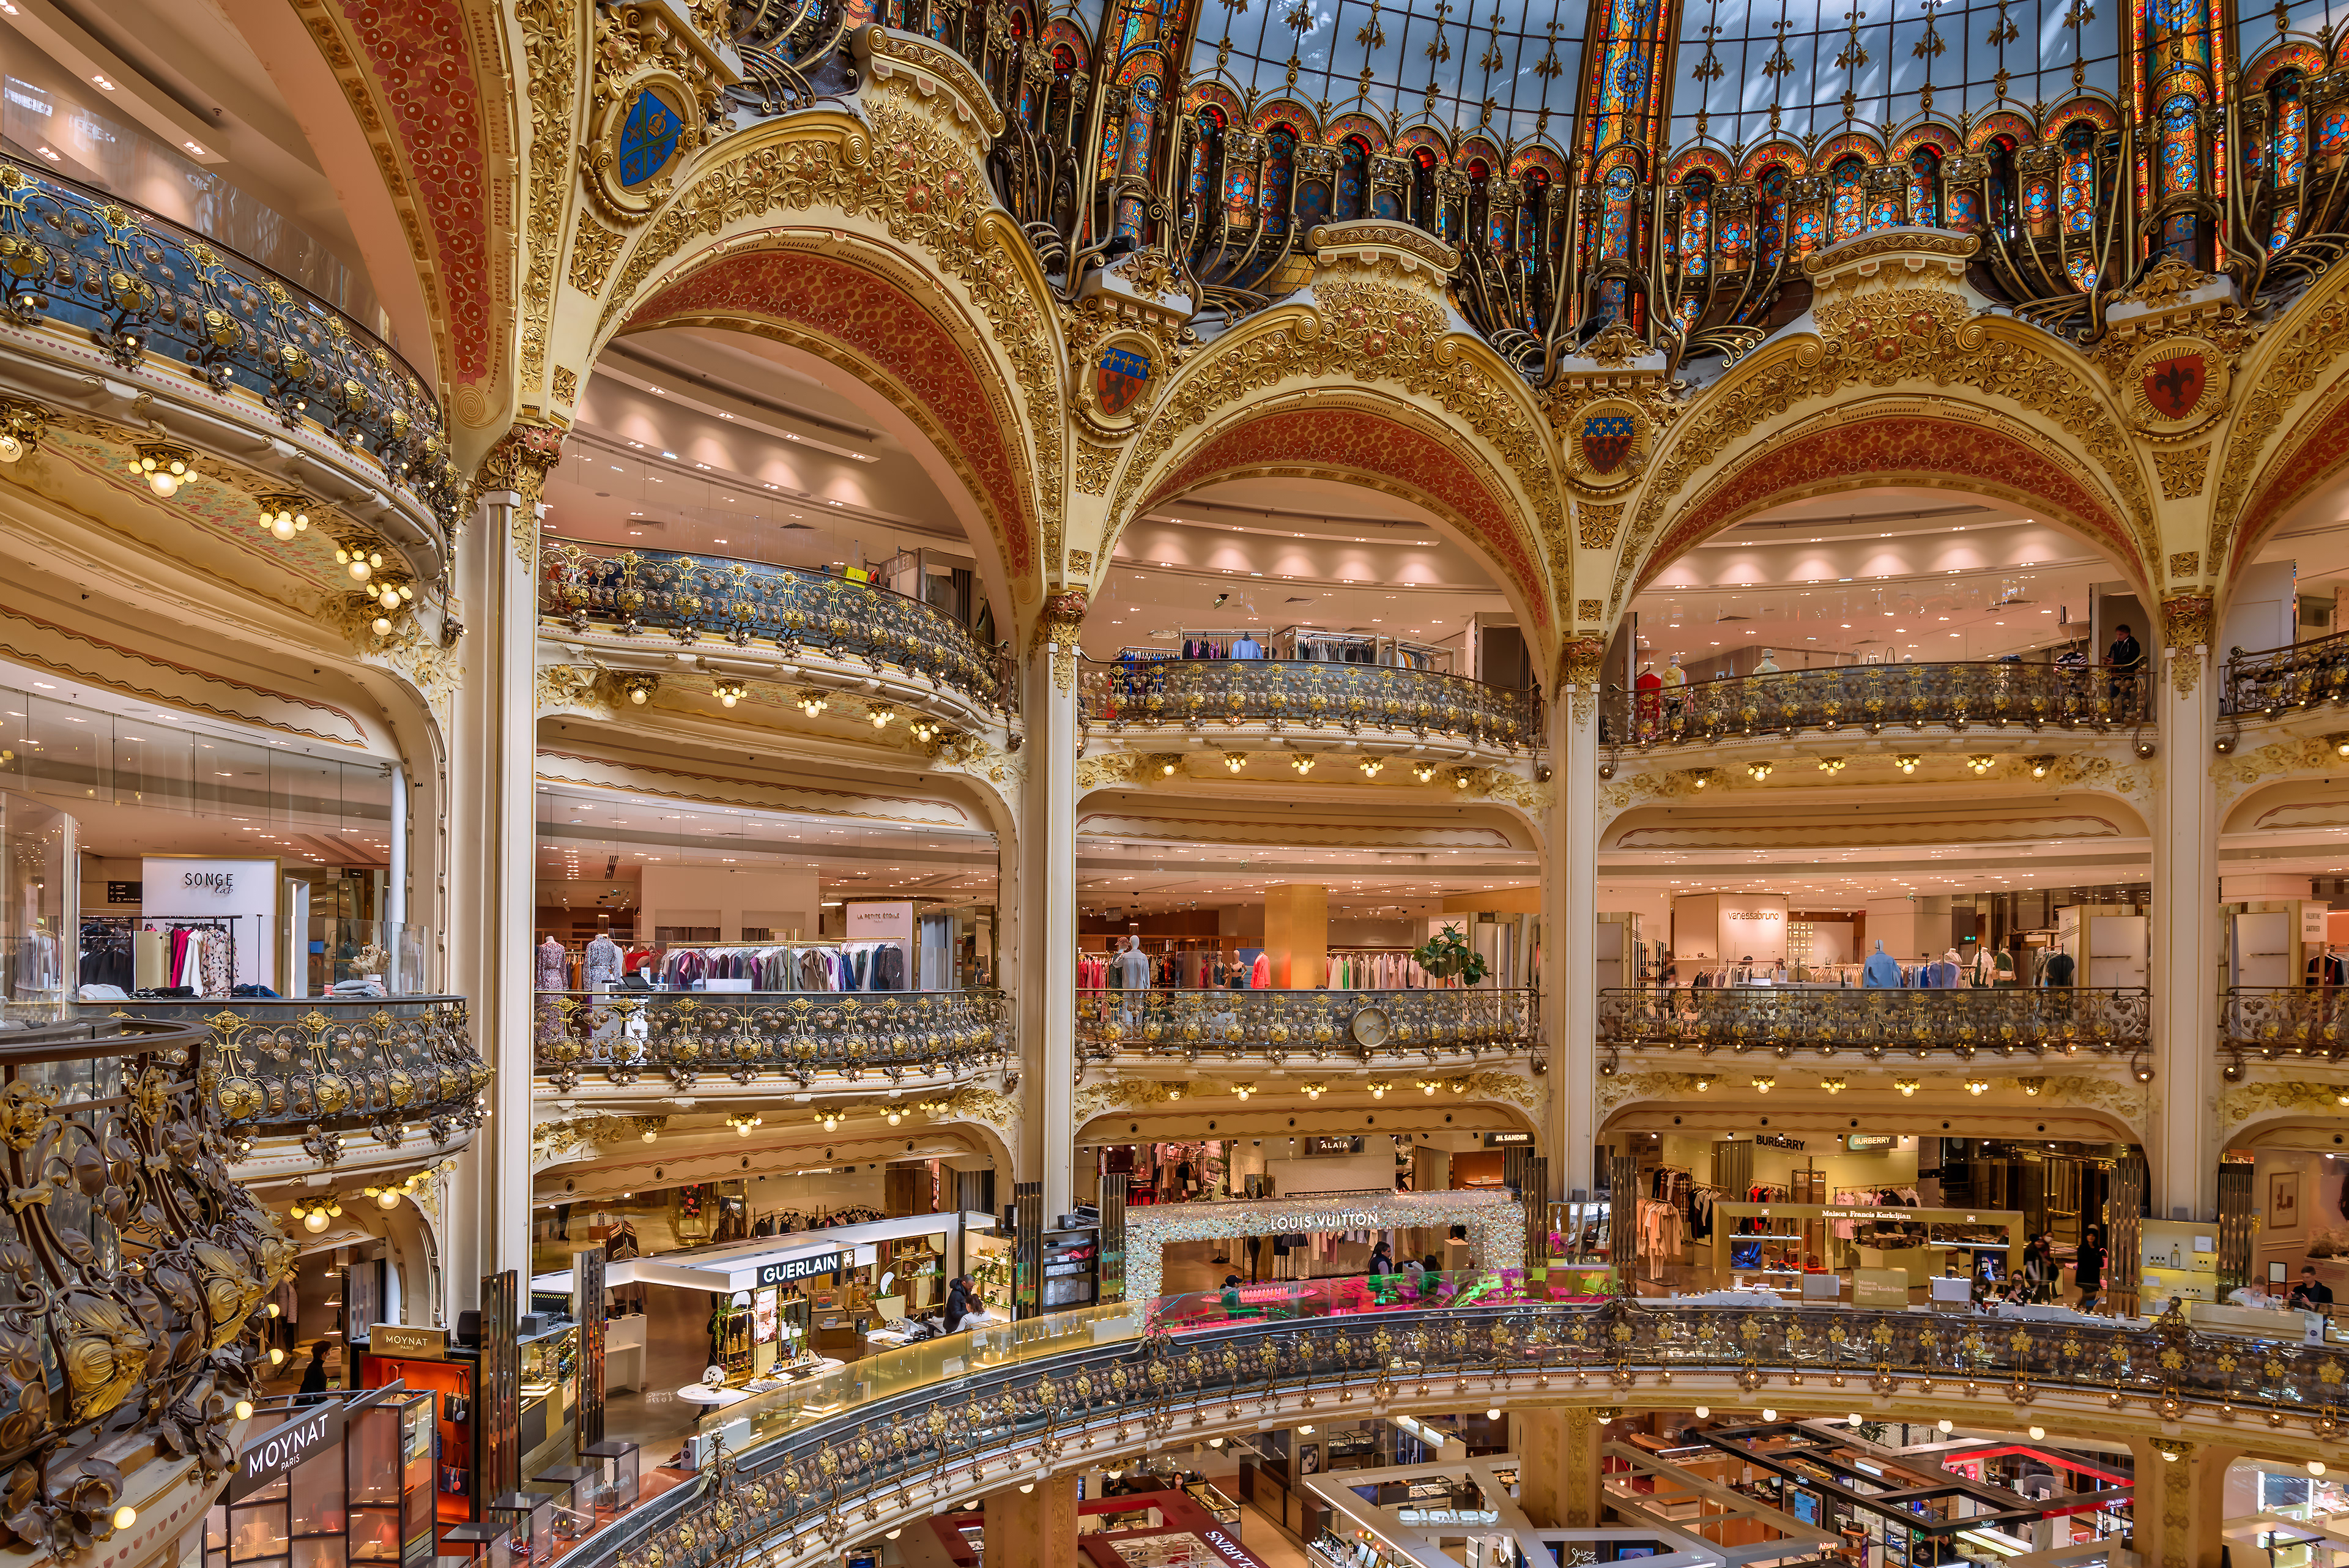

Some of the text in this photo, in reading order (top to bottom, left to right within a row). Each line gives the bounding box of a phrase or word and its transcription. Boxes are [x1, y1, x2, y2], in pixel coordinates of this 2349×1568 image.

[185, 873, 234, 886] SONGE
[215, 882, 234, 894] lab
[1727, 910, 1779, 920] vanessabruno
[1756, 1135, 1805, 1151] BURBERRY
[1854, 1136, 1891, 1145] BURBERRY
[1271, 1213, 1378, 1230] LOUIS VUITTON
[1876, 1211, 1911, 1221] Kurkdjian
[763, 1255, 837, 1283] GUERLAIN
[386, 1335, 428, 1346] MOYNAT
[249, 1413, 328, 1478] MOYNAT
[281, 1454, 300, 1471] PARIS
[1205, 1531, 1260, 1568] LARINS
